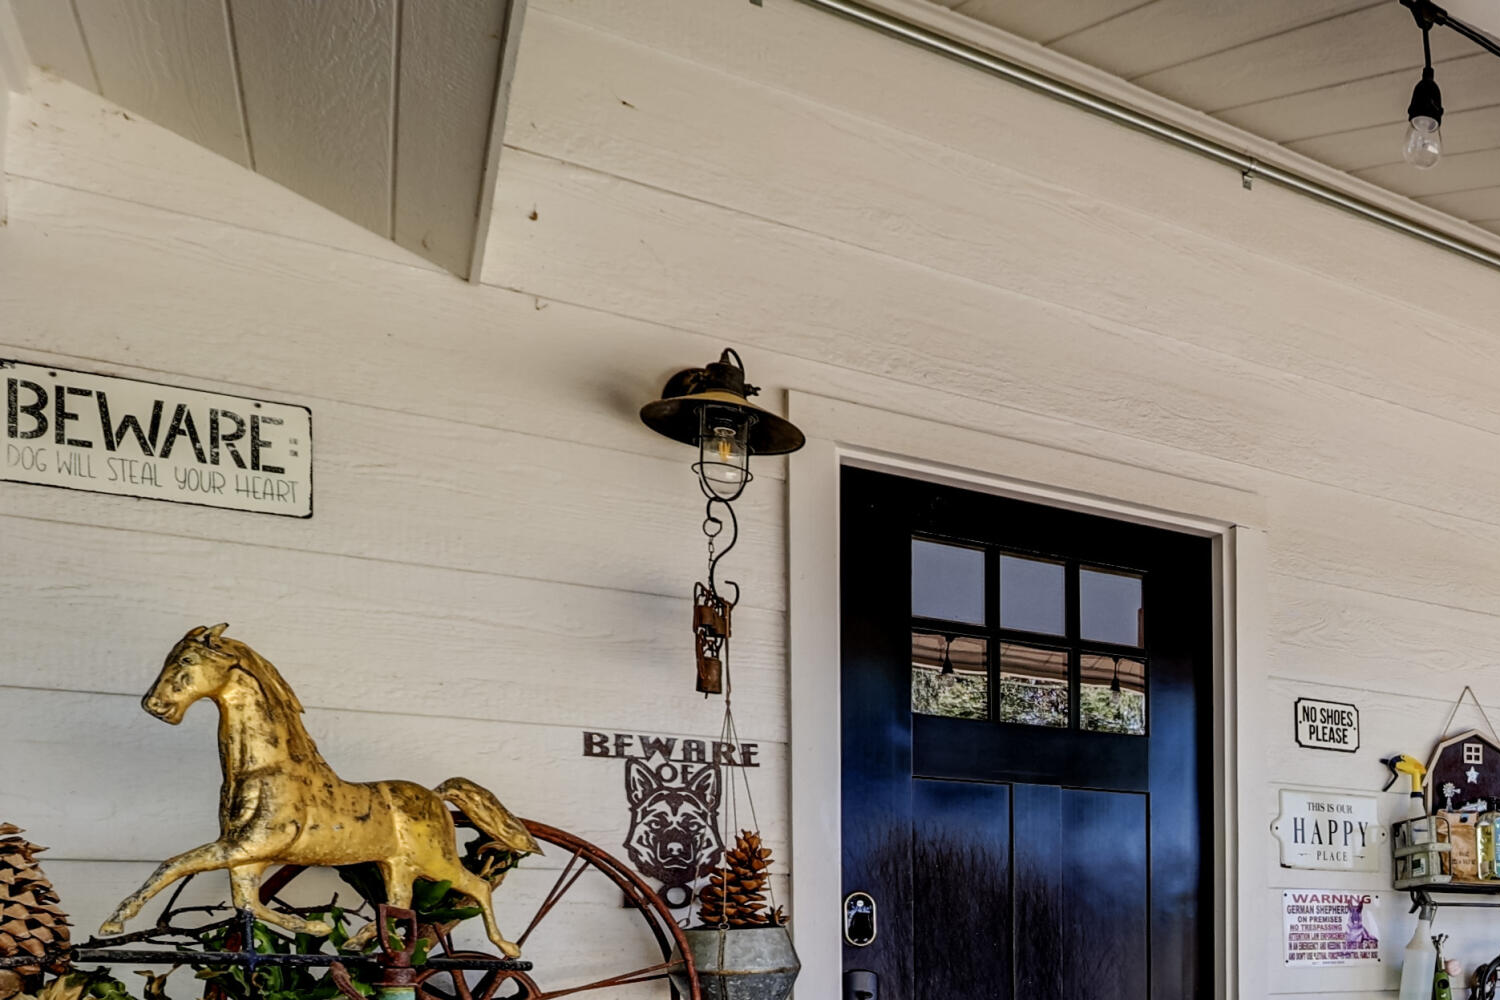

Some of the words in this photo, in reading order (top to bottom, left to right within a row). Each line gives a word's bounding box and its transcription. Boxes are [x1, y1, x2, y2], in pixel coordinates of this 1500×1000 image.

[6, 444, 48, 473] DOG
[56, 450, 96, 479] WILL
[106, 457, 163, 488] STEAL
[174, 466, 226, 495] YOUR
[235, 475, 299, 504] HEART
[1302, 704, 1317, 723] NO
[1320, 707, 1354, 727] SHOES
[1309, 724, 1349, 744] PLEASE
[582, 731, 761, 767] BEWARE
[655, 762, 695, 785] OF
[1307, 801, 1325, 813] THIS
[1327, 802, 1335, 813] IS
[1336, 803, 1353, 814] OUR
[1293, 817, 1369, 847] HAPPY
[1316, 850, 1348, 862] PLACE
[1292, 894, 1371, 904] WARNING
[1287, 905, 1315, 915] GERMAN
[1316, 905, 1349, 915] SHEPHERD
[1301, 924, 1342, 932] TRESPASSING
